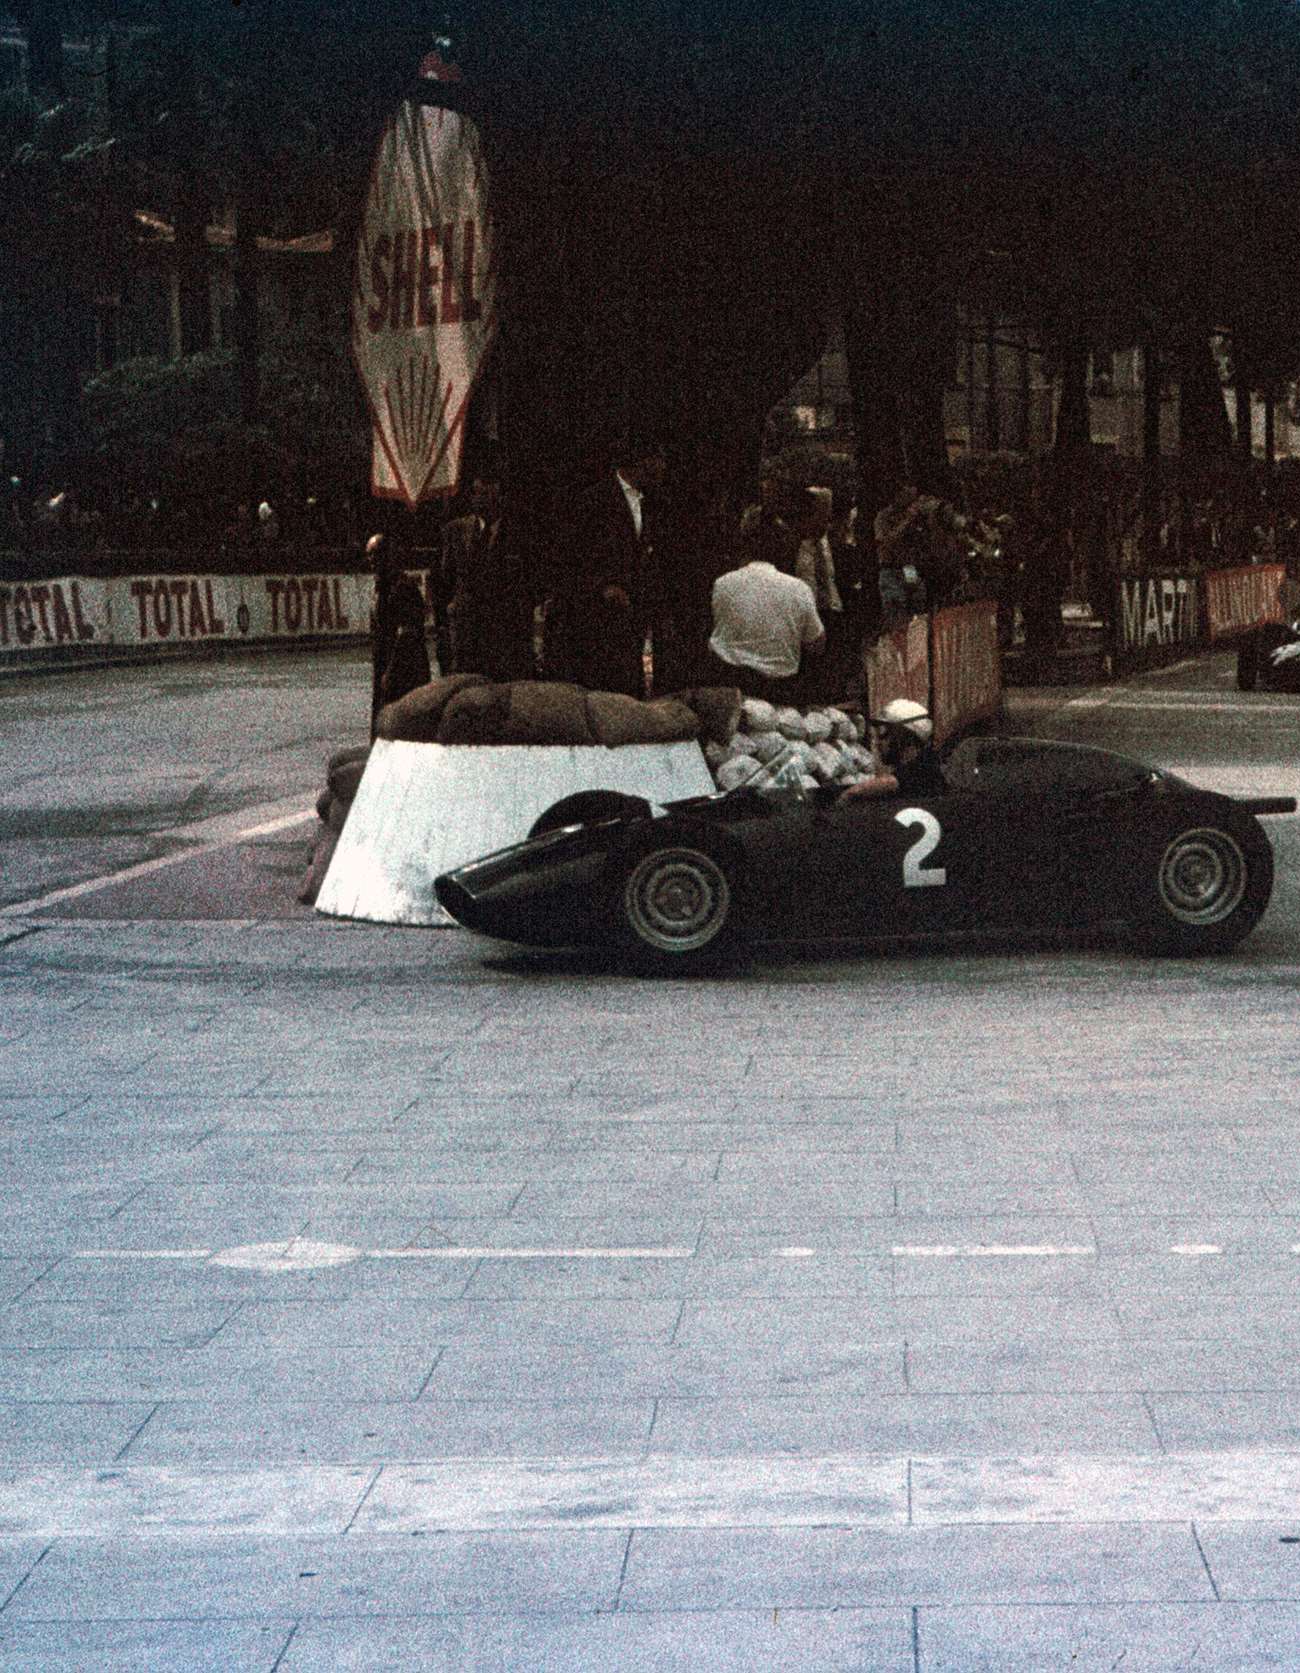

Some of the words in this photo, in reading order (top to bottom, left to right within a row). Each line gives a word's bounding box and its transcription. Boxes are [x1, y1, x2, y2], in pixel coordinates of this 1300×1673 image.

[367, 219, 481, 333] SHELL
[130, 578, 225, 638] TOTAL
[265, 578, 349, 633] TOTAL
[894, 807, 946, 888] 2
